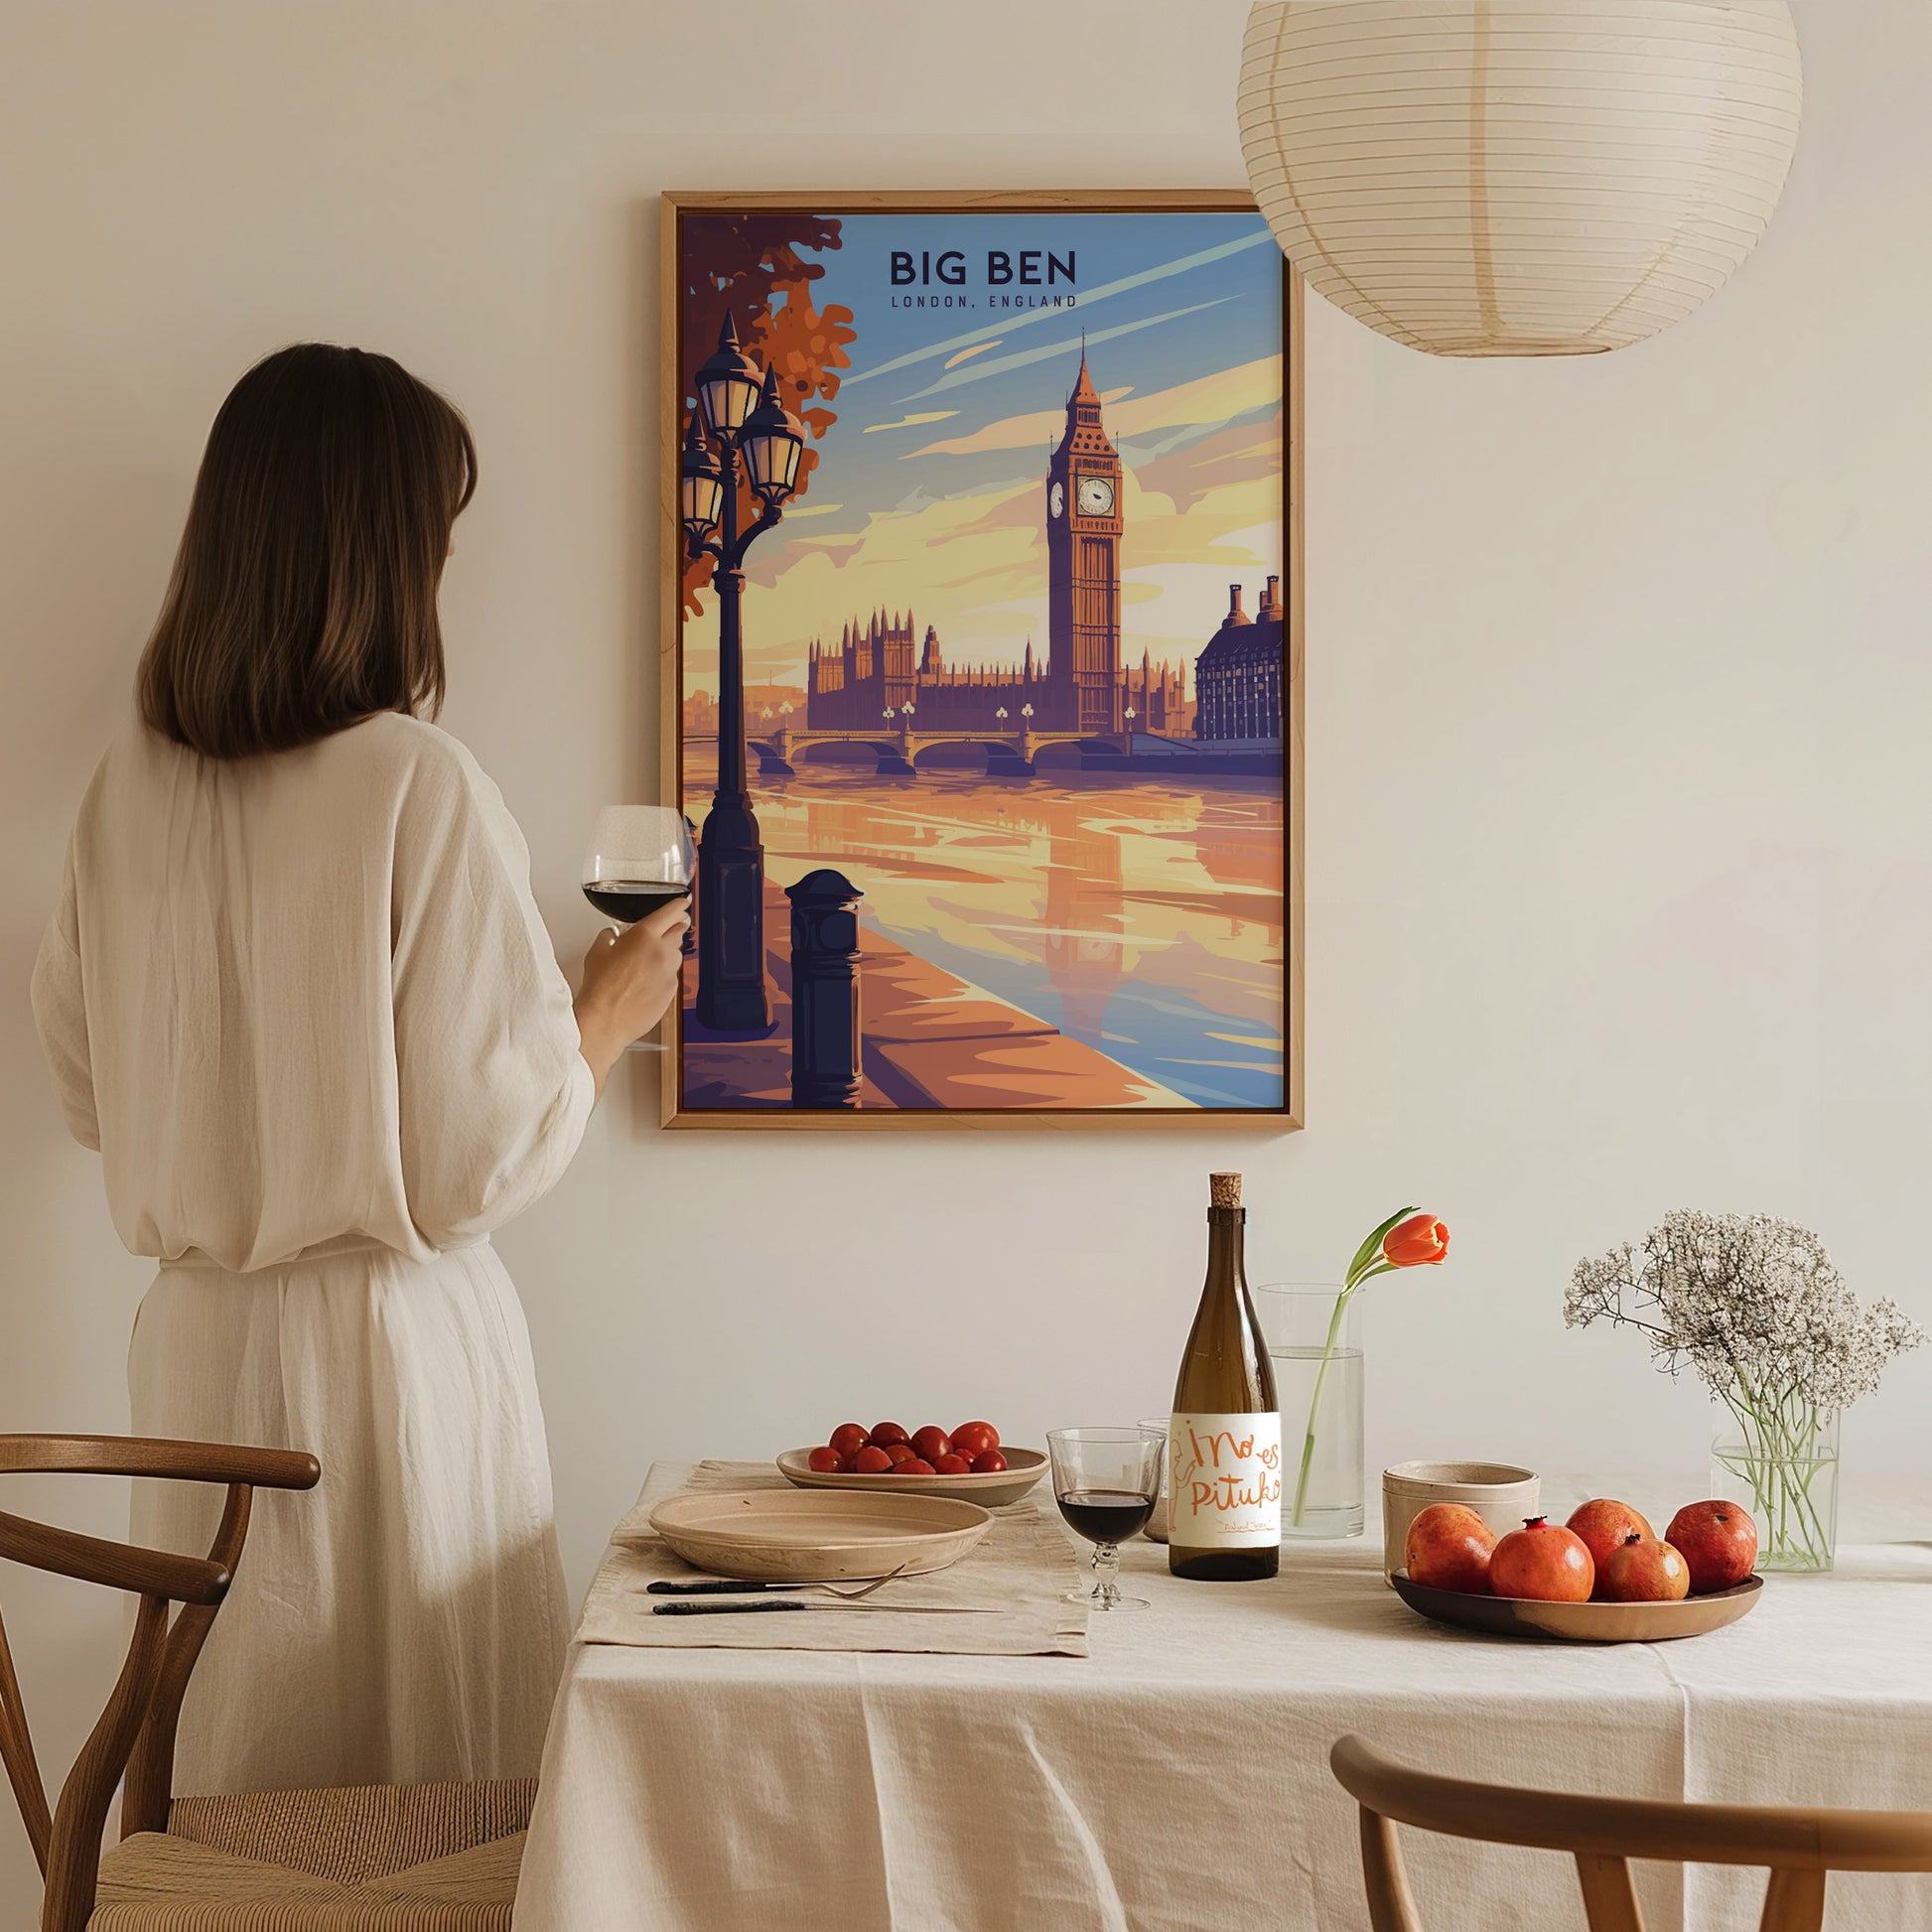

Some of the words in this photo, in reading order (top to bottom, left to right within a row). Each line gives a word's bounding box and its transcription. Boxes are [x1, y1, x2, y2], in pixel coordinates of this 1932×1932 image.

[891, 250, 966, 285] BIG
[987, 250, 1076, 285] BEN
[891, 296, 975, 309] LONDON,
[989, 295, 1076, 308] ENGLAND
[1256, 1444, 1279, 1470] es
